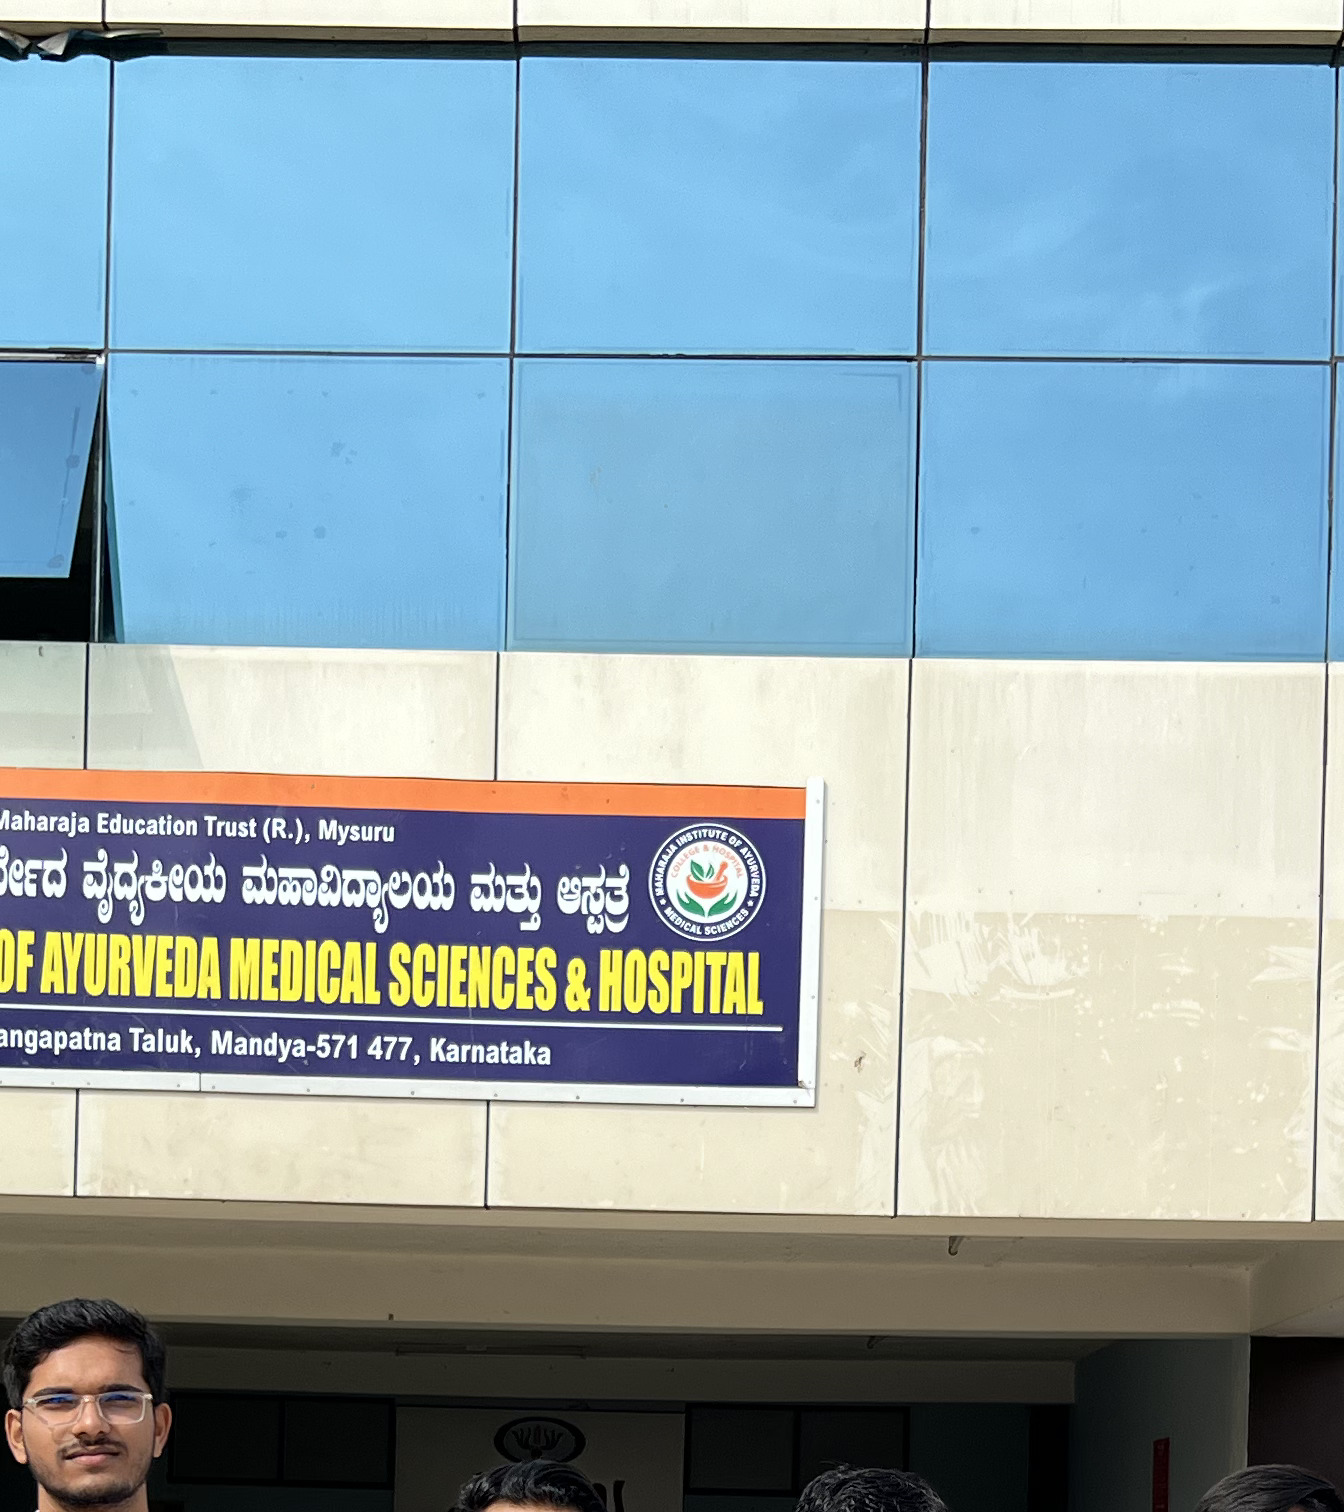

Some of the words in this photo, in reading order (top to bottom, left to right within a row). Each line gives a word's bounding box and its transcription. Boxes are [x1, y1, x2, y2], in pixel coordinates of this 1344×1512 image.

[97, 813, 197, 836] Education
[204, 816, 257, 838] Trust
[263, 817, 310, 844] (R.),
[318, 819, 394, 845] Mysuru
[654, 844, 678, 896] MAHARAJA
[676, 829, 729, 846] INSTITUTE
[728, 836, 742, 848] OF
[740, 847, 760, 897] AYURVEDA
[671, 846, 700, 878] COLLEGE
[703, 844, 709, 852] &
[713, 845, 744, 878] HOSPITAL
[83, 849, 226, 925] ವೈದ್ಯಕೀಯ
[242, 854, 455, 933] ಮಹಾವಿದ್ಯಾಲಯ
[470, 862, 541, 931] ಮತ್ತು
[557, 864, 629, 934] ಆಸ್ಪತ್ರೆ
[664, 907, 702, 935] MEDICAL
[704, 908, 749, 935] SCIENCES
[42, 932, 220, 998] AYURVEDA
[230, 938, 380, 1004] MEDICAL
[390, 942, 556, 1010] SCIENCES
[566, 958, 590, 1010] &
[600, 950, 763, 1014] HOSPITAL
[129, 1027, 200, 1058] Taluk,
[211, 1030, 357, 1064] Mandya-571
[367, 1036, 420, 1065] 477,
[430, 1038, 550, 1065] Karnataka
